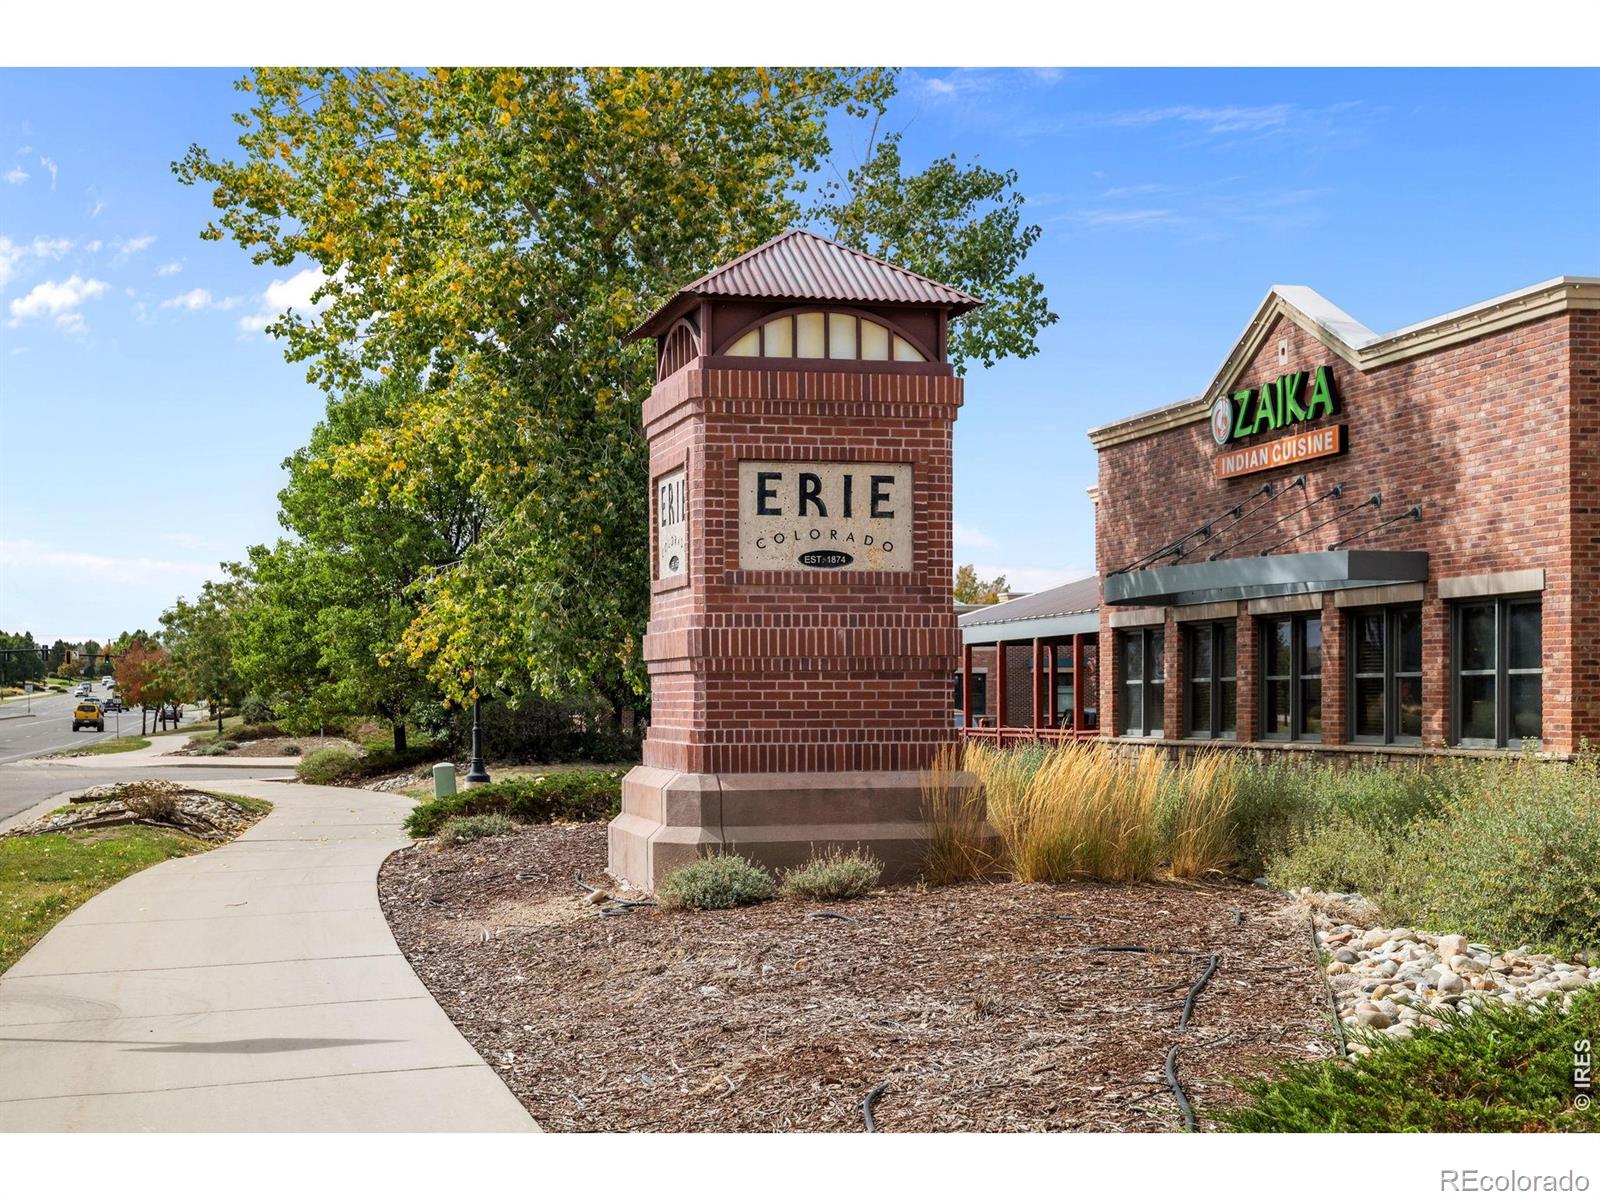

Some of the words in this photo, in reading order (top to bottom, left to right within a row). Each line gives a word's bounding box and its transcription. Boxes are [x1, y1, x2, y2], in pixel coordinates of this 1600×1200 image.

[1232, 365, 1336, 439] ZAIKA
[1221, 447, 1269, 475] INDIAN
[1271, 431, 1334, 463] CUISINE
[756, 472, 895, 519] ERIE
[756, 528, 894, 553] COLORADO
[827, 555, 846, 564] 1874
